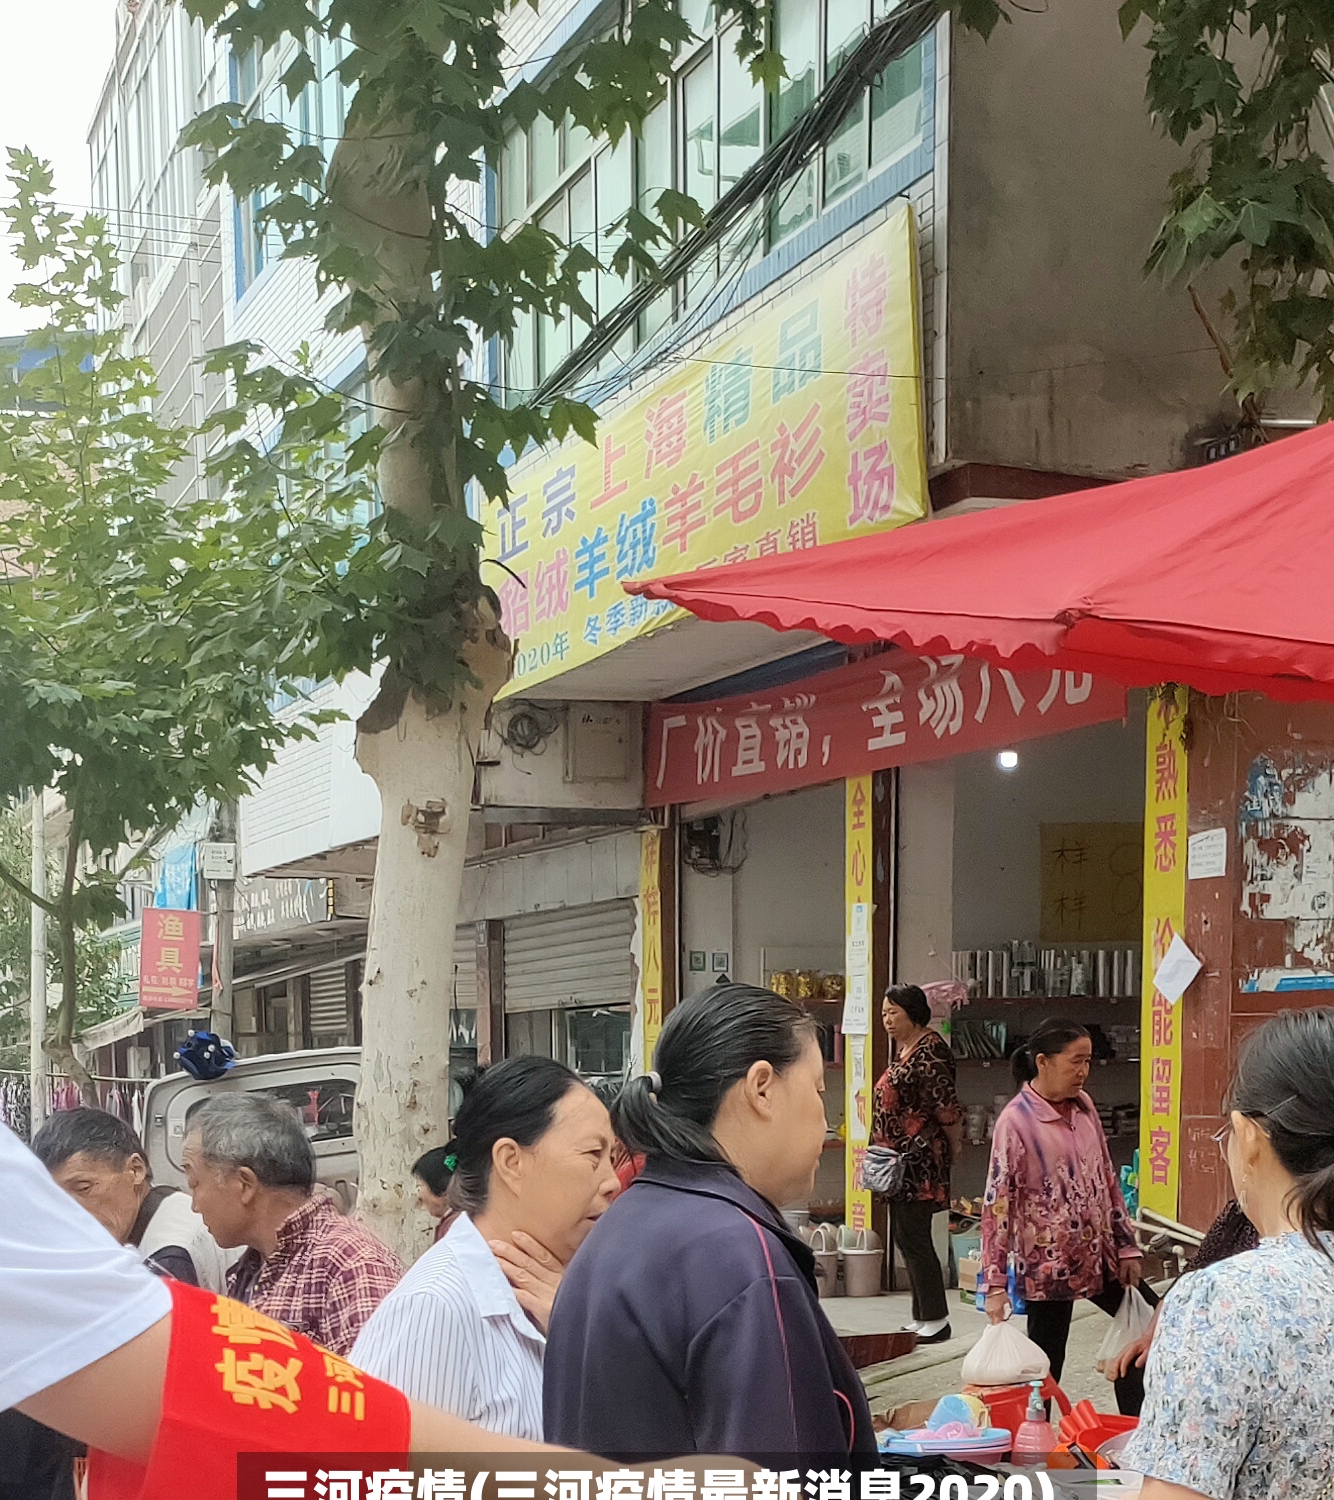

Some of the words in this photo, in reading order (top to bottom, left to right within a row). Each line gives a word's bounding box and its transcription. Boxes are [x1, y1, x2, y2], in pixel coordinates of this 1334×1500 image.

[496, 296, 824, 565] 正宗上海精品
[842, 248, 896, 528] 特卖场
[513, 630, 571, 679] 020年
[156, 913, 185, 974] 渔具
